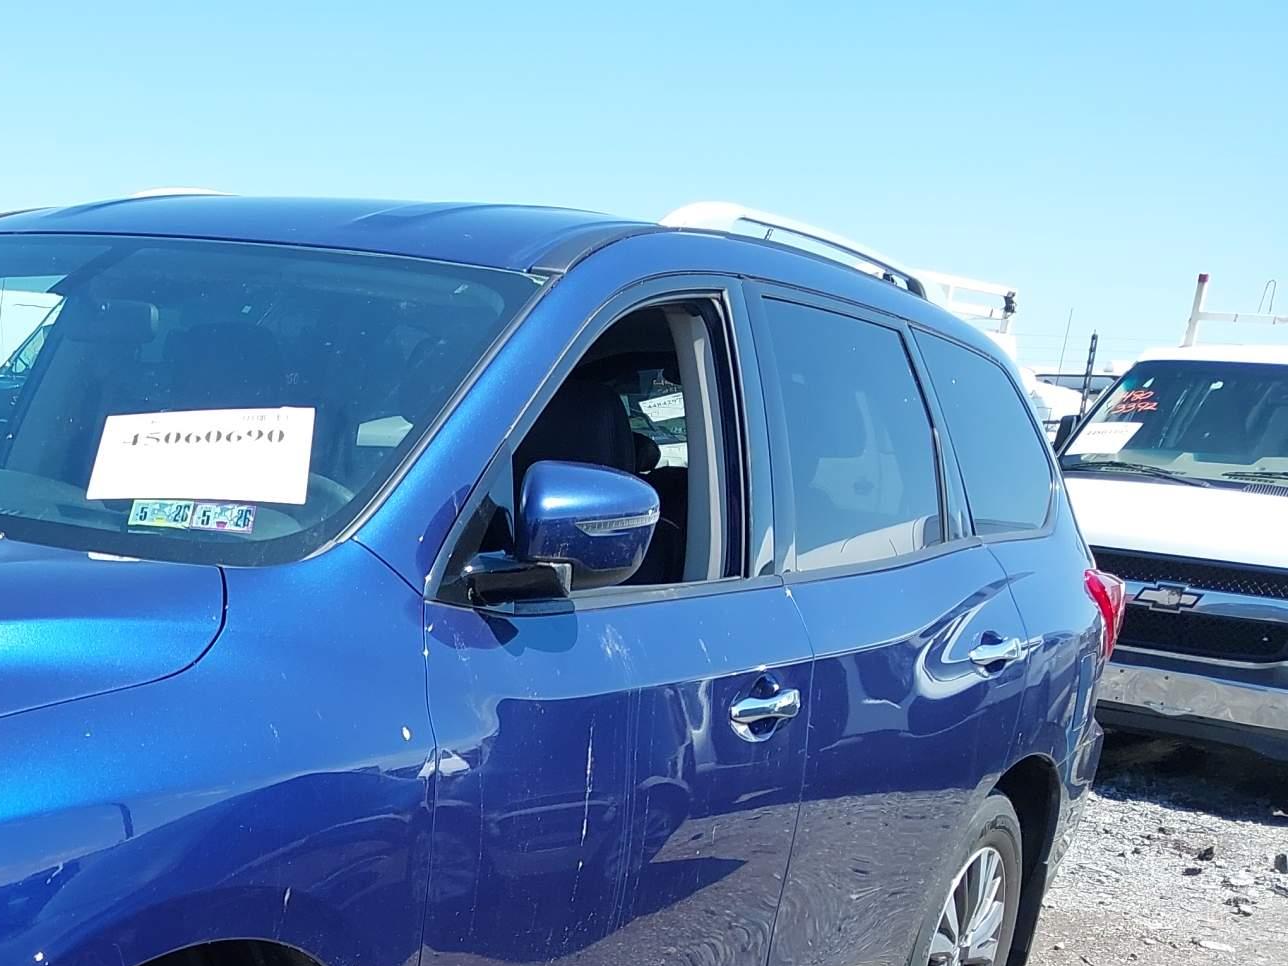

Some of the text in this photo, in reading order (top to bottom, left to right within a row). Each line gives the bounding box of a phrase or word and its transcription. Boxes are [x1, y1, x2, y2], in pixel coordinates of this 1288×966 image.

[121, 428, 286, 447] 45060690
[139, 504, 191, 522] 5 26
[201, 508, 252, 528] 5 26
